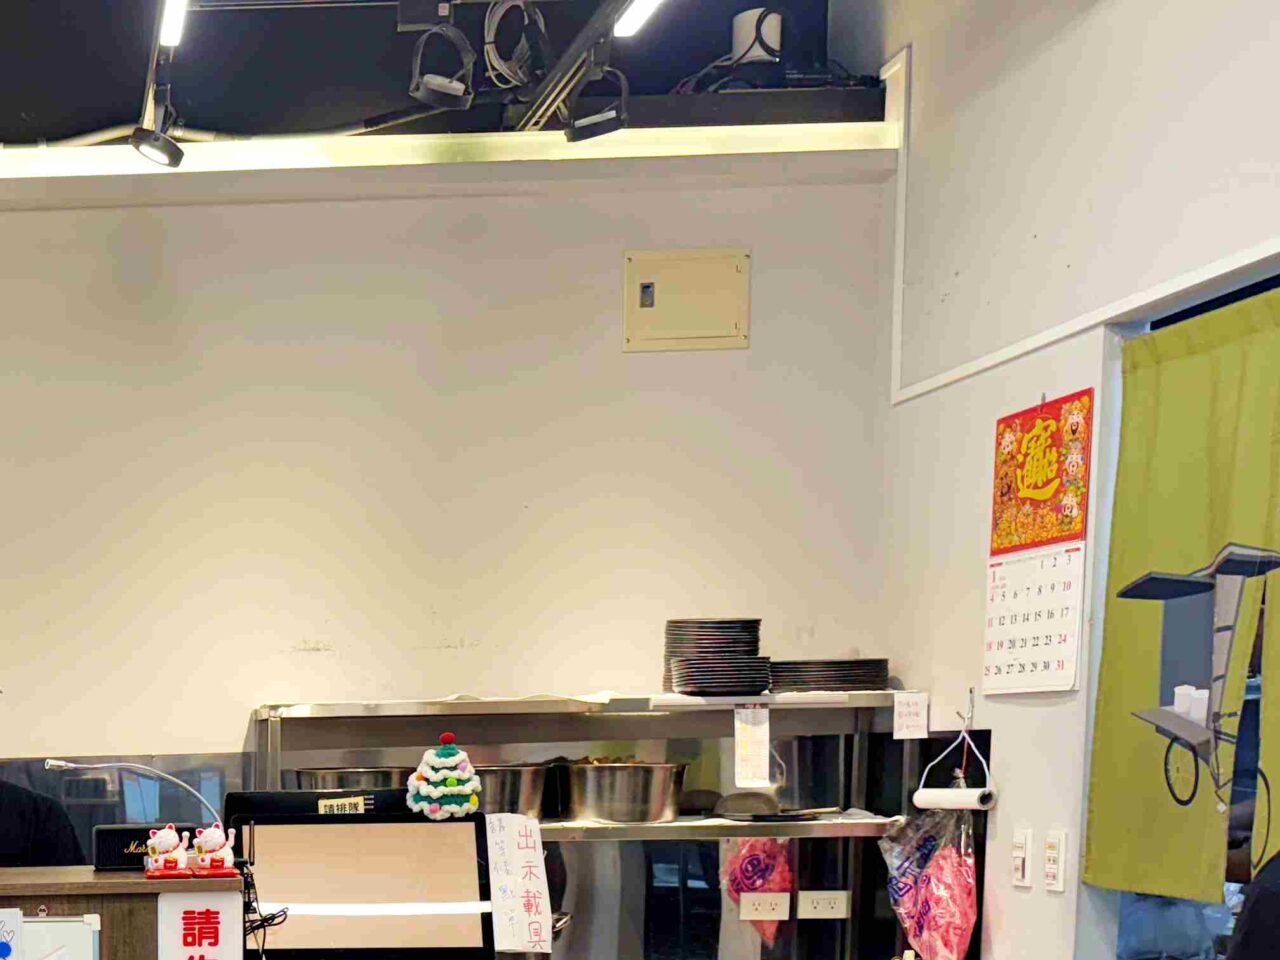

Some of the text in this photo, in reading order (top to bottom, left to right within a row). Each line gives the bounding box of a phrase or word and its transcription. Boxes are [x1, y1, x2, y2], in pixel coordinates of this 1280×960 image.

[1013, 591, 1018, 599] 6
[1038, 585, 1042, 595] 8
[1051, 583, 1055, 592] 9
[1063, 581, 1072, 592] 10
[999, 616, 1005, 626] 12
[1011, 614, 1017, 624] 13
[1023, 613, 1029, 623] 14
[1035, 611, 1041, 621] 15
[1047, 609, 1054, 619] 16
[1061, 607, 1069, 618] 17
[997, 640, 1004, 650] 19
[1008, 639, 1016, 649] 20
[1019, 638, 1027, 648] 21
[1032, 636, 1039, 647] 22
[1044, 635, 1052, 645] 23
[1058, 634, 1067, 644] 24
[994, 665, 1002, 675] 26
[1006, 664, 1014, 674] 27
[1018, 663, 1025, 673] 28
[1030, 662, 1037, 672] 29
[1041, 661, 1050, 671] 30
[1056, 659, 1064, 670] 31
[323, 801, 360, 814] 請排隊
[517, 824, 547, 950] 出示載具
